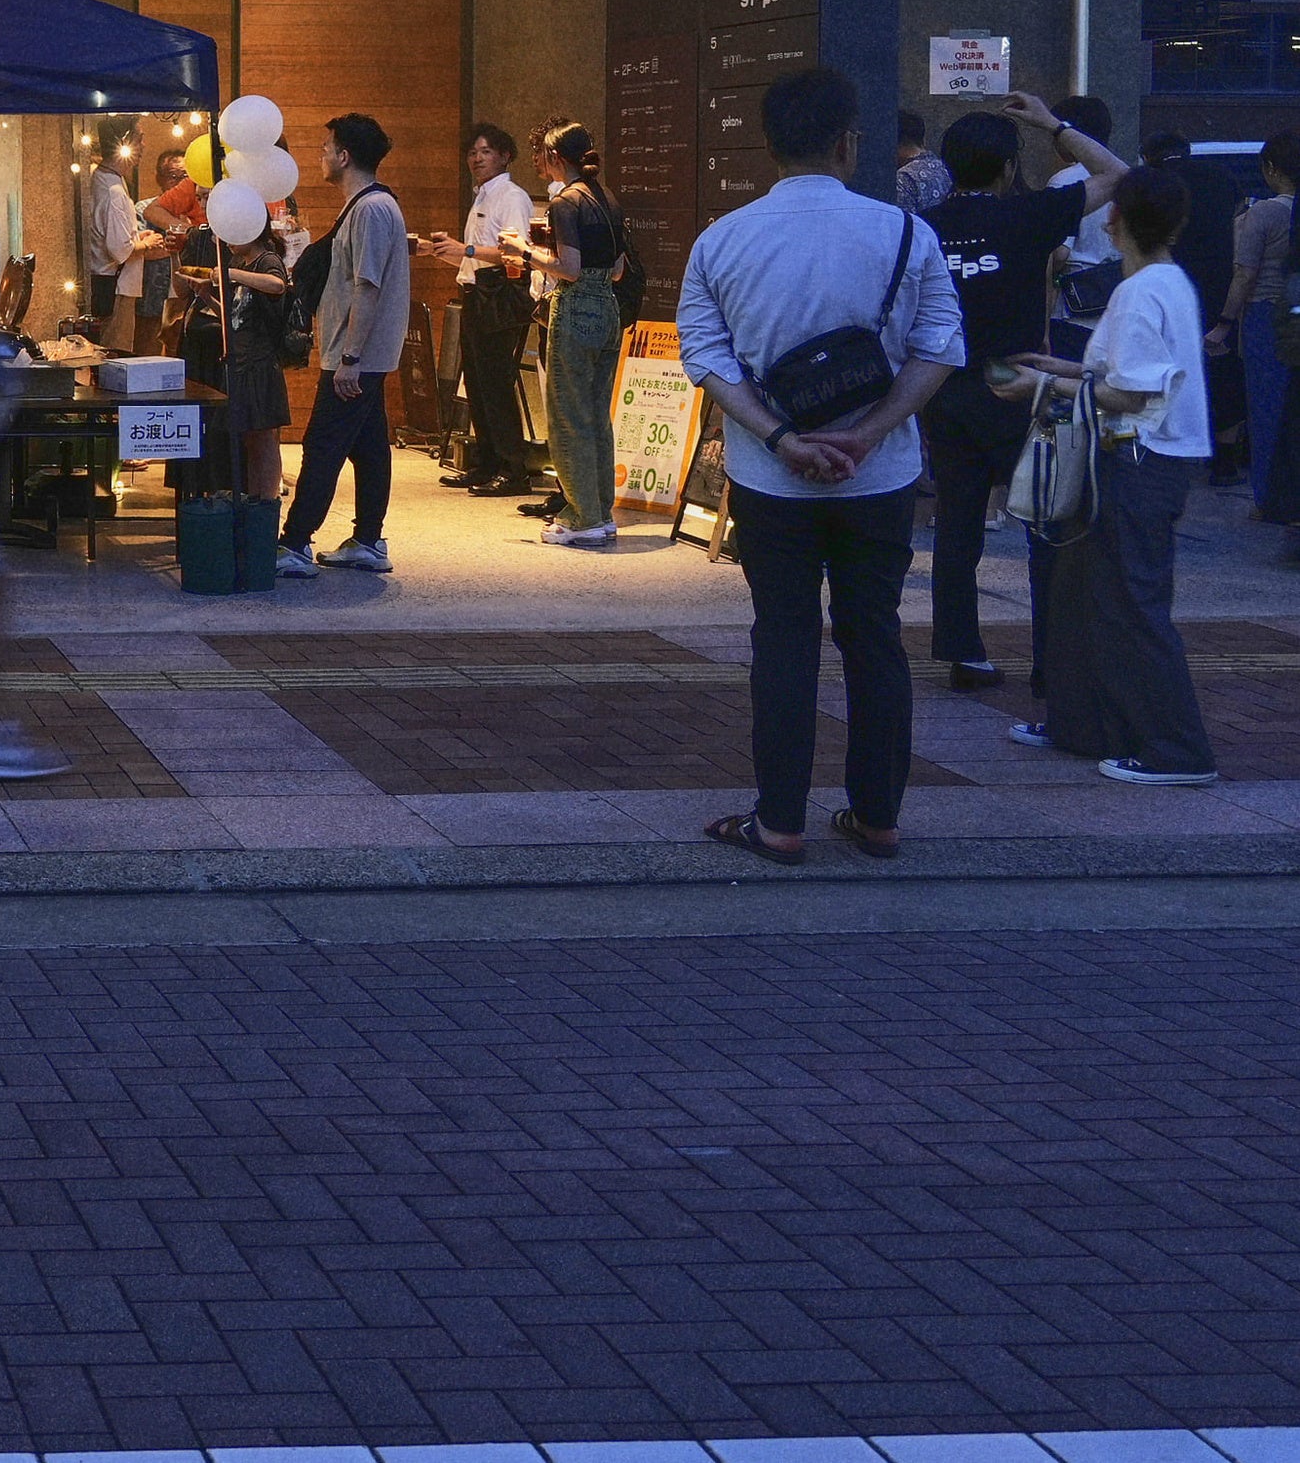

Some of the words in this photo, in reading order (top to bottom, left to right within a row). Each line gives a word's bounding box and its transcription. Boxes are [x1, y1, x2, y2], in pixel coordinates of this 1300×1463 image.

[710, 36, 717, 50] 5
[962, 40, 978, 49] 現金
[955, 52, 985, 61] QR決済
[939, 62, 1000, 71] Web事前購入者
[710, 97, 716, 109] 4
[708, 157, 716, 170] 3
[628, 377, 688, 392] LINEお友だち登録
[146, 411, 174, 421] フード
[129, 424, 191, 440] お渡し口
[647, 423, 678, 446] 30%
[644, 446, 661, 457] OFF
[629, 468, 643, 479] 全品
